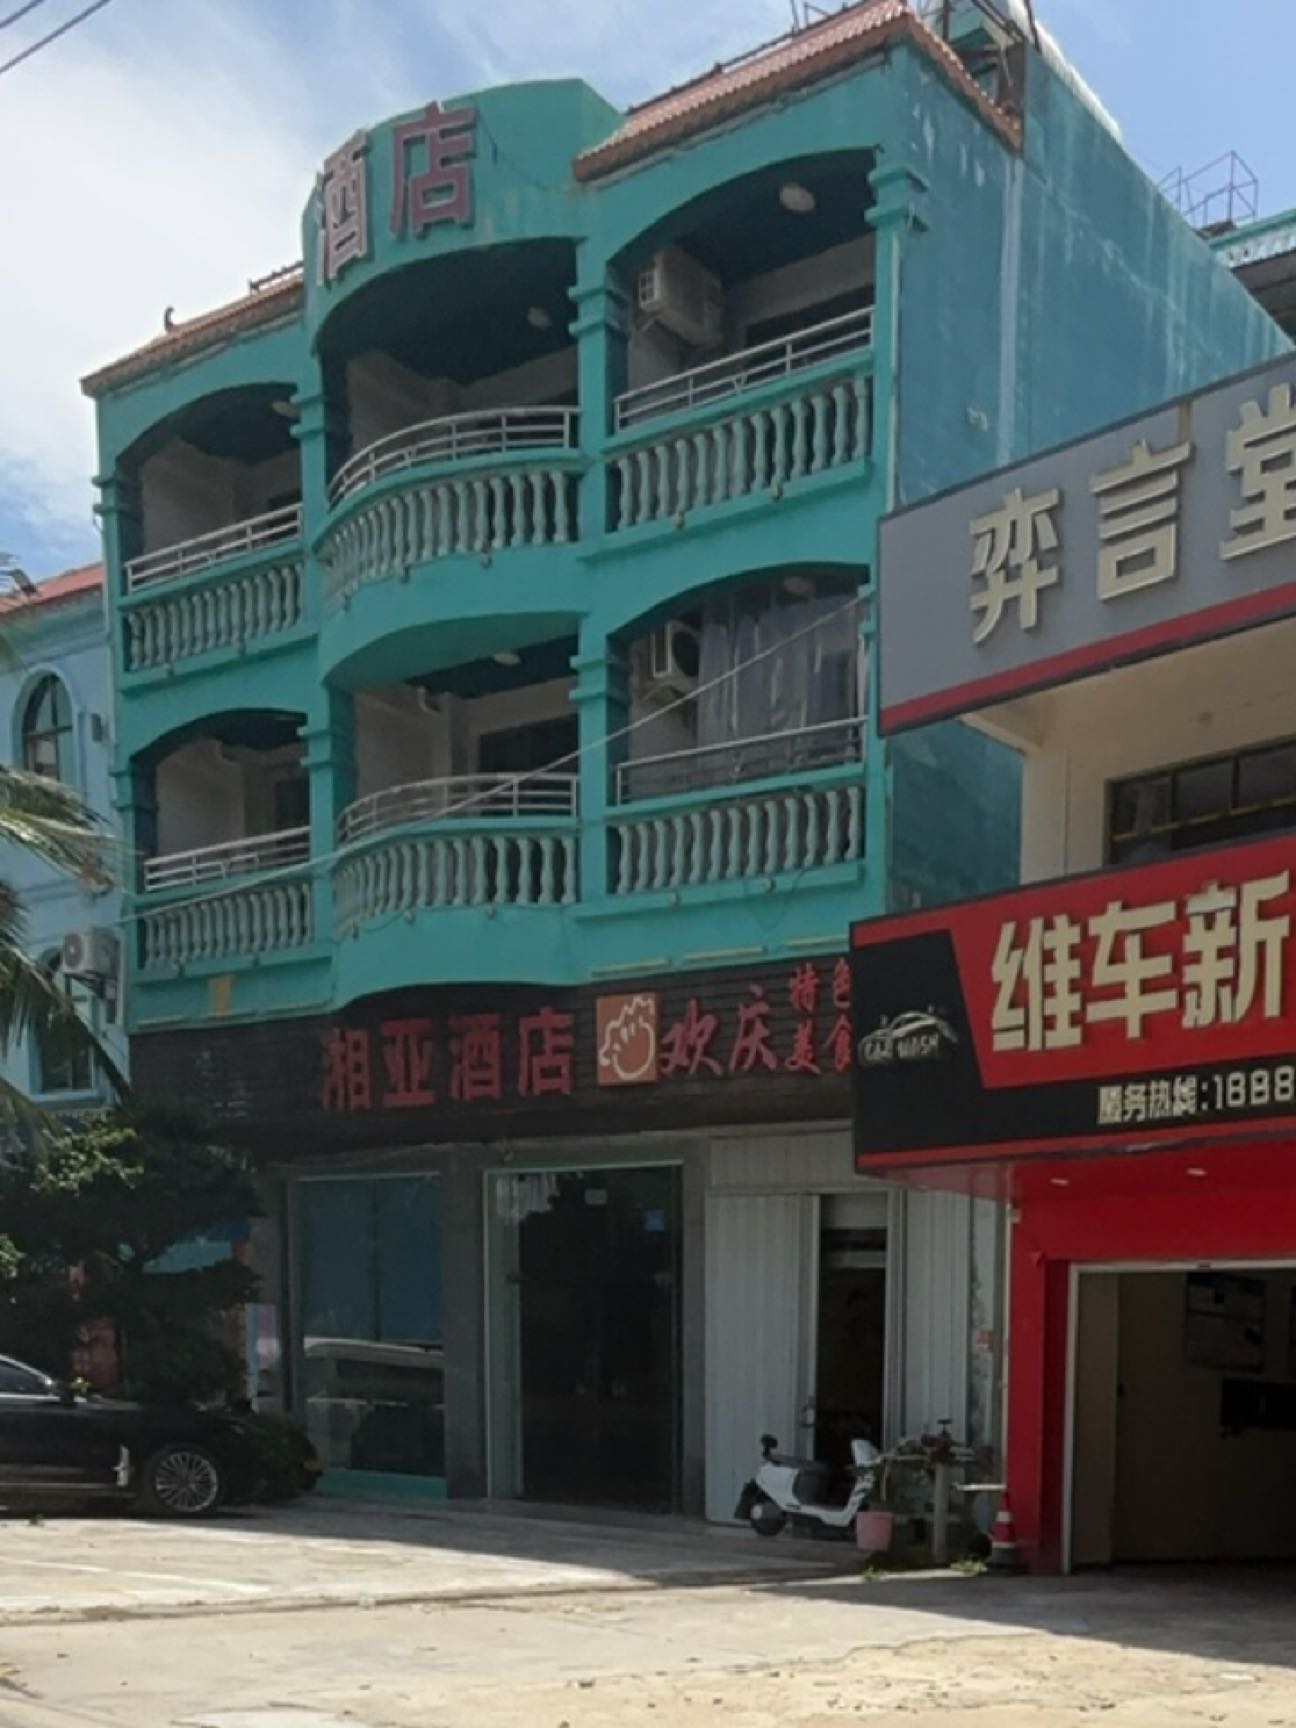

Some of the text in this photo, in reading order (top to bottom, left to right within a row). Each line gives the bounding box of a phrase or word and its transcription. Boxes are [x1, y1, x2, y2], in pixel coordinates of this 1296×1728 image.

[315, 100, 477, 287] 酒店
[661, 984, 778, 1075] 欢庆
[991, 870, 1290, 1052] 维车新
[321, 1006, 576, 1110] 湘亚酒店
